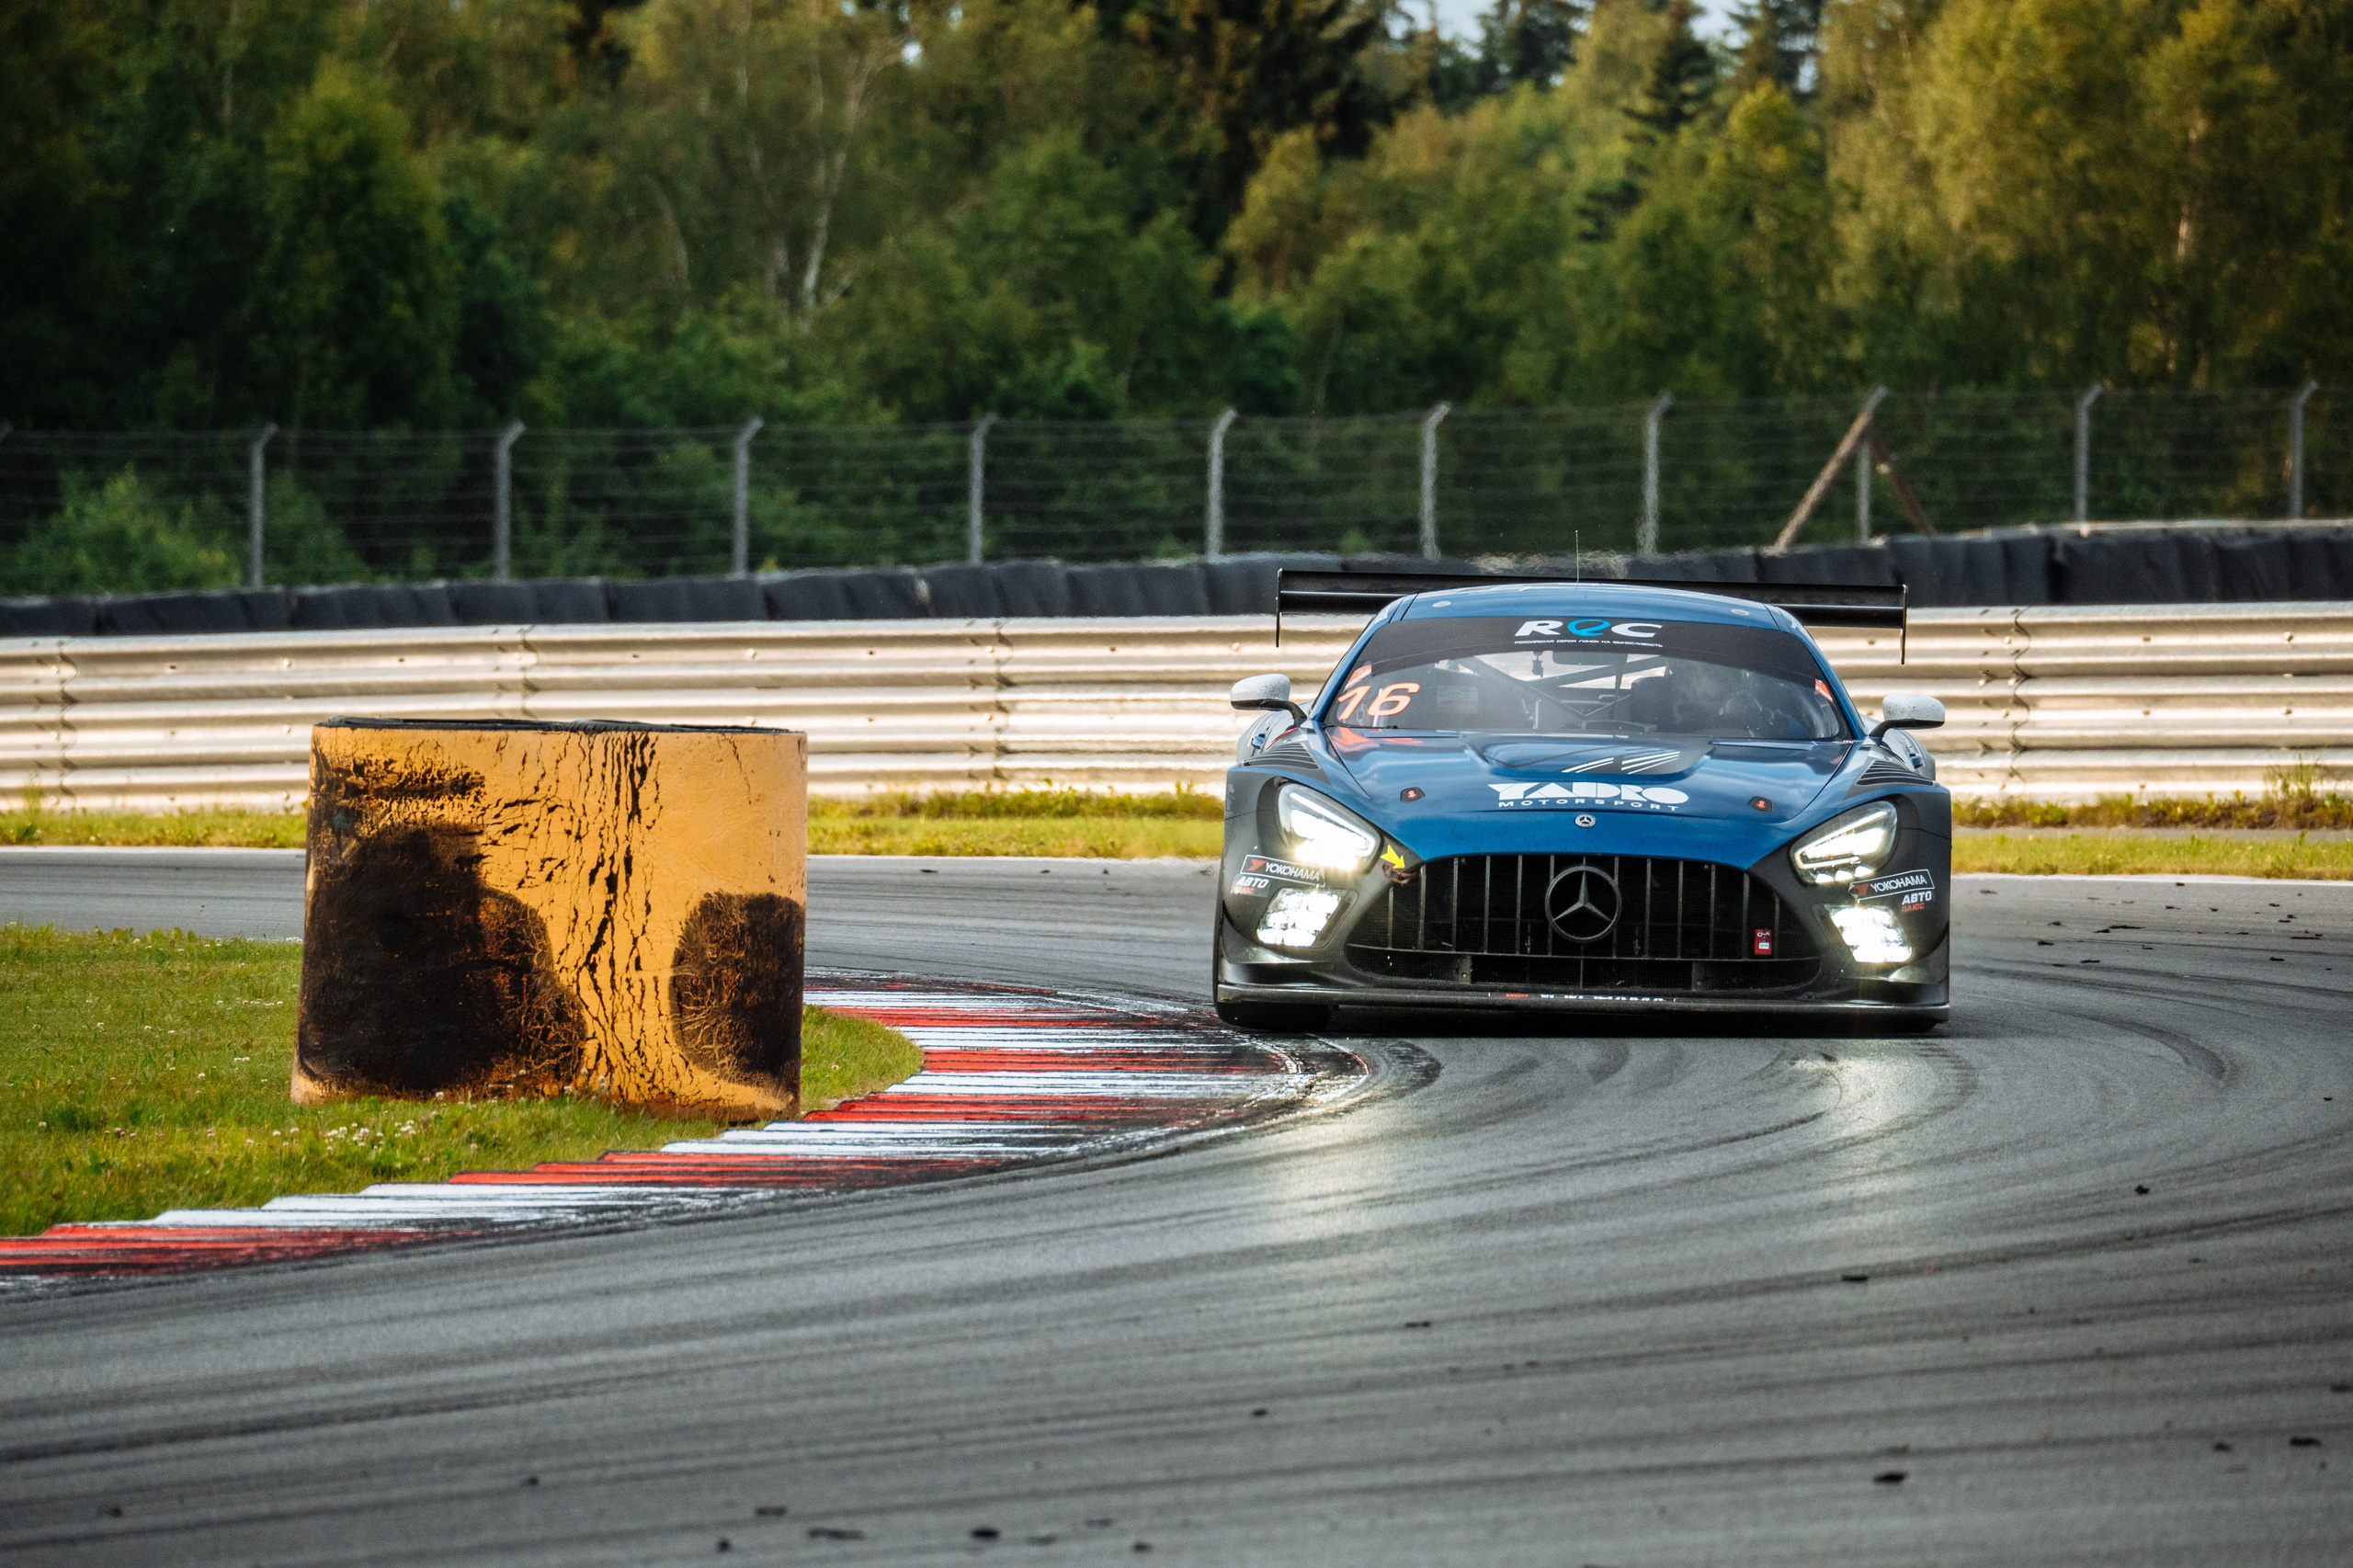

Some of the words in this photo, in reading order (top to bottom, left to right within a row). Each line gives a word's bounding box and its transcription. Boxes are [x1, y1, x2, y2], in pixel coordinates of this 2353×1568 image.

[1336, 682, 1421, 722] 16
[1487, 781, 1689, 805] YADRO
[1498, 799, 1679, 812] MOTORSPORT
[1265, 861, 1321, 882] YOKOHAMA
[1235, 875, 1270, 889] АВТО
[1870, 874, 1927, 892] YOKOHAMA
[1902, 891, 1932, 905] АВТО
[1902, 902, 1925, 913] ПЛЮС
